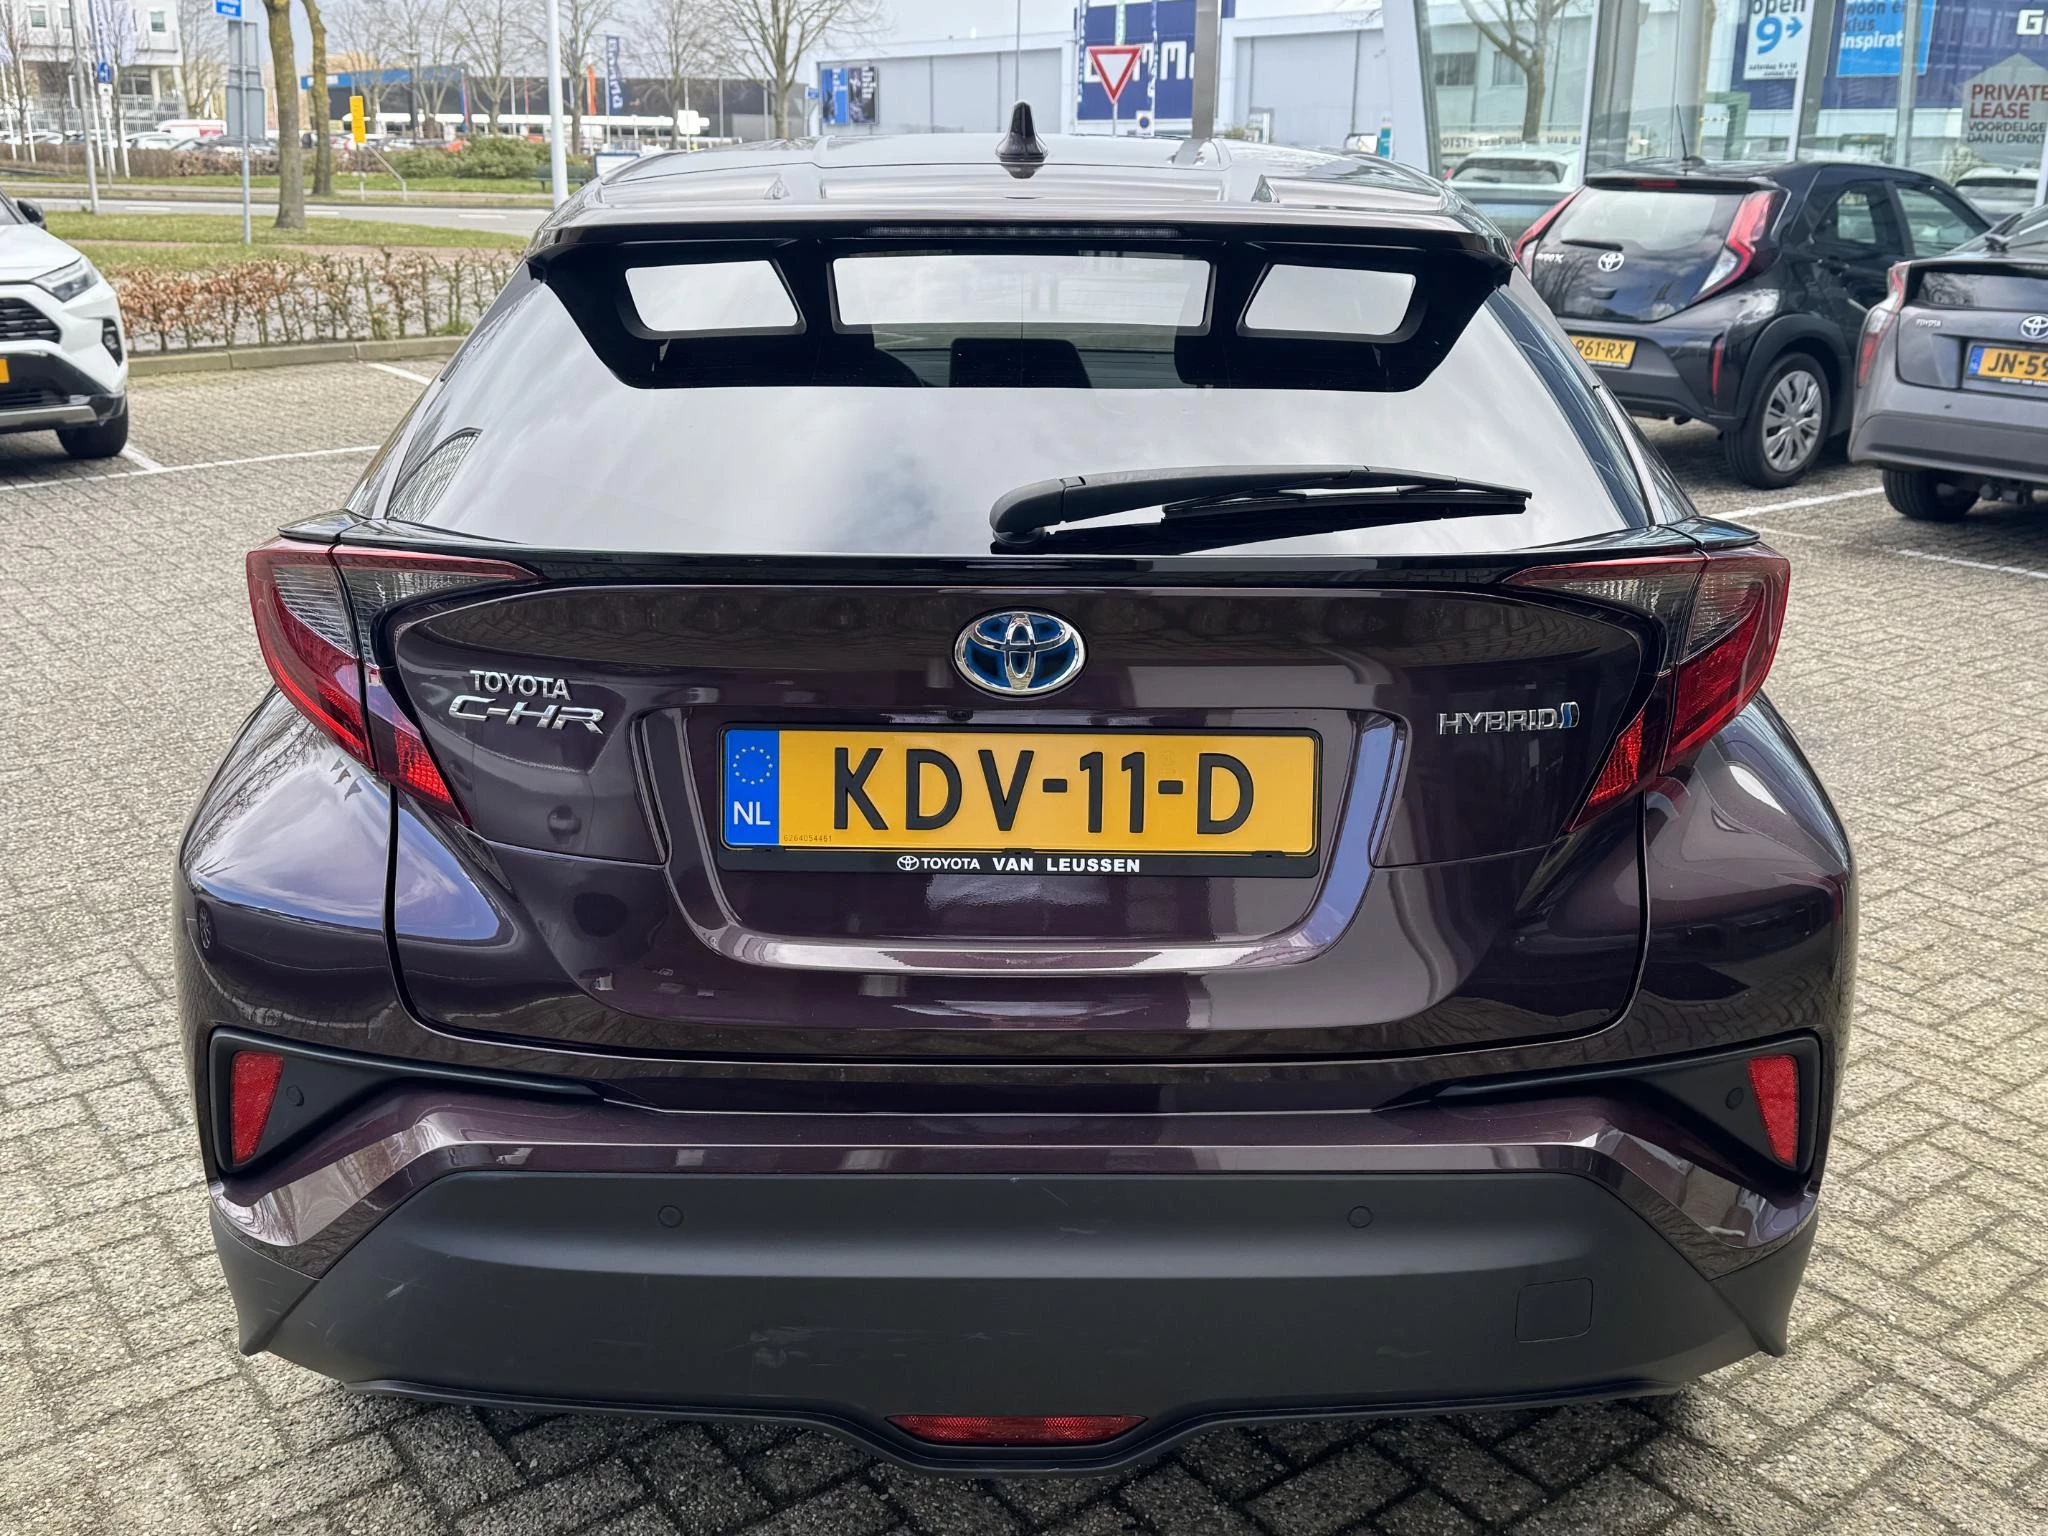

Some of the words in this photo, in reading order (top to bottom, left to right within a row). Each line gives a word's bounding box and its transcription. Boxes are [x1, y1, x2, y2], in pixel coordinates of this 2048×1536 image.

[1752, 0, 1806, 17] open
[2016, 9, 2048, 35] G
[1756, 16, 1782, 54] 9
[1840, 30, 1903, 52] inspirat
[1970, 83, 2048, 101] PRIVATE
[1969, 102, 2031, 119] LEASE
[1967, 121, 2047, 132] VOORDELIGE
[1967, 132, 1994, 143] DAN
[1996, 133, 2005, 143] U
[469, 669, 572, 701] TOYOTA
[449, 694, 604, 735] C-HR
[1439, 708, 1558, 735] HYBRID
[834, 746, 1254, 836] KDV-11-D
[733, 801, 771, 826] NL
[920, 857, 981, 870] TOYOTA
[992, 857, 1034, 871] VAN
[1046, 858, 1141, 873] LEUSSEN
